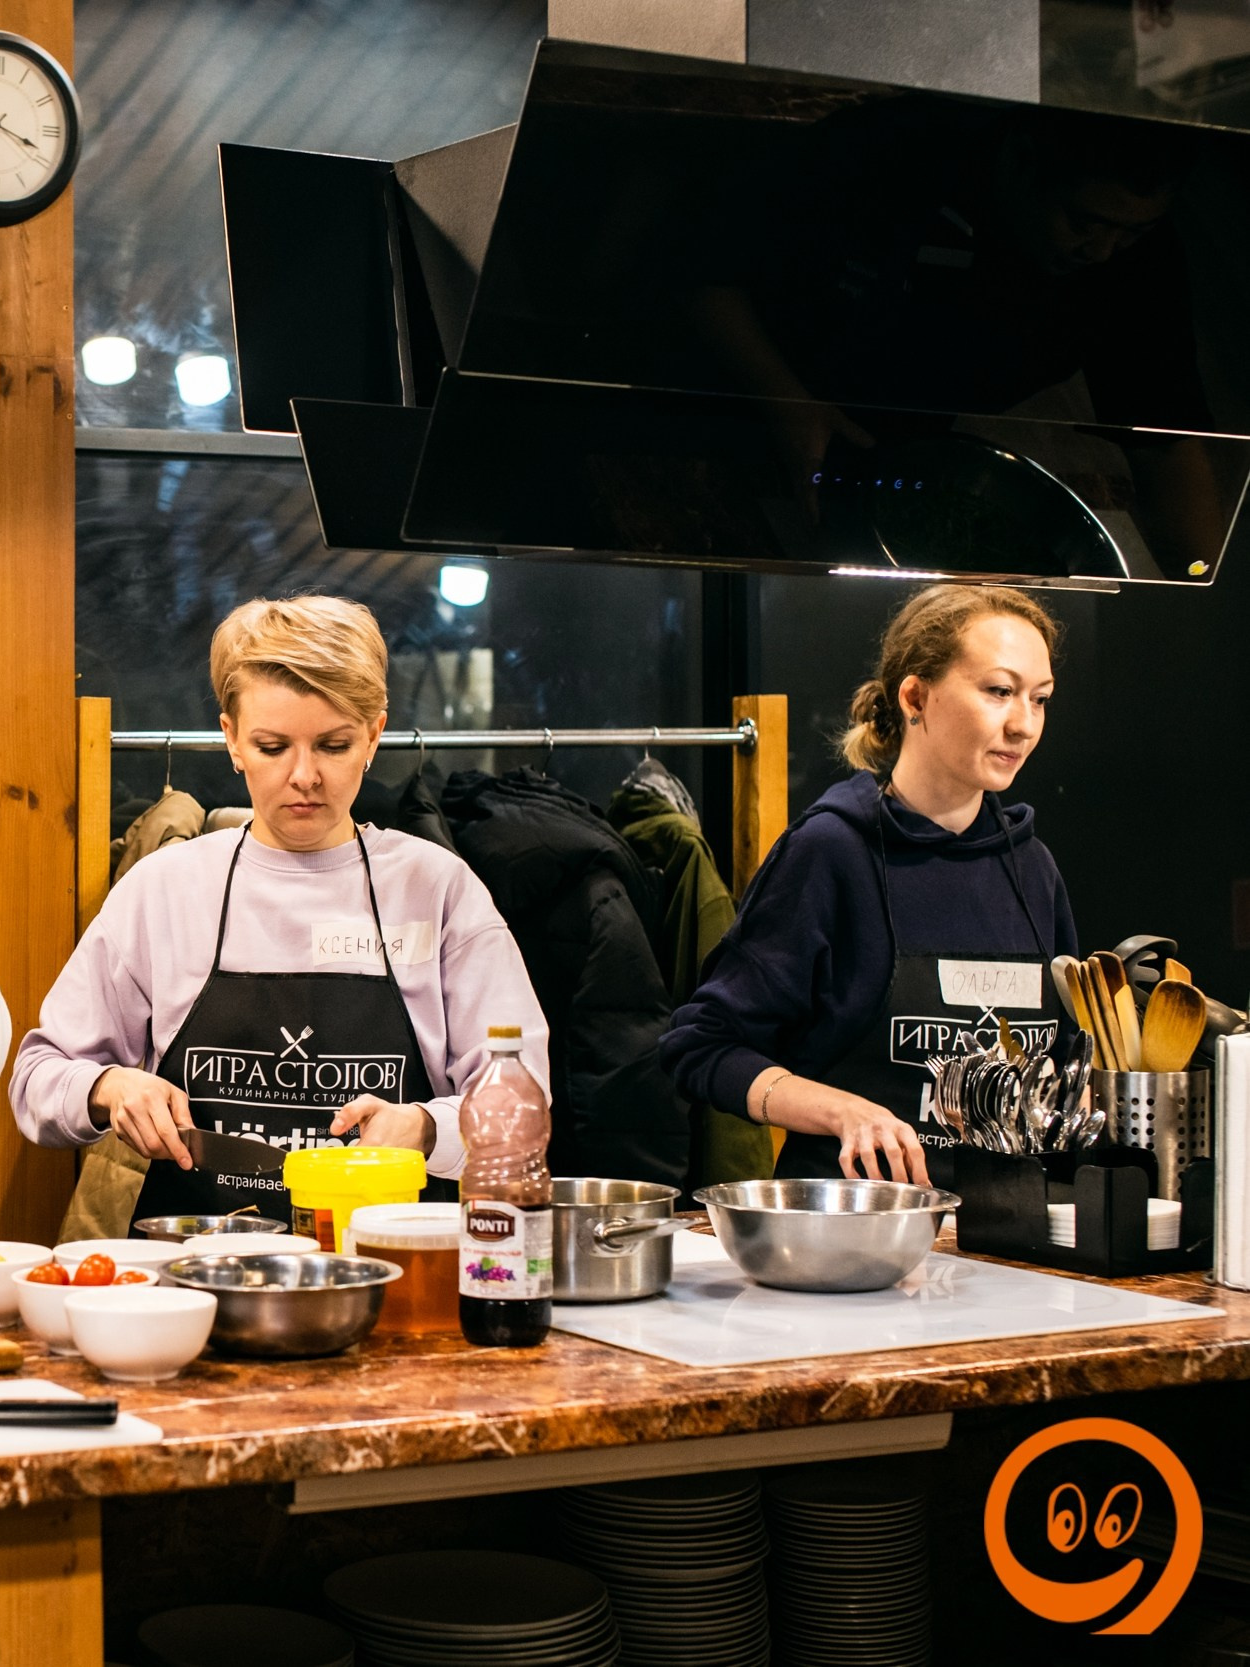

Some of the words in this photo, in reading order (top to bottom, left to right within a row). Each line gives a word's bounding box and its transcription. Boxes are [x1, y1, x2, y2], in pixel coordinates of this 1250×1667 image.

[318, 935, 404, 957] КСЕНИЯ
[952, 970, 1018, 995] ОЛЬГА
[899, 1023, 969, 1052] ИГРА
[191, 1054, 268, 1087] ИГРА
[274, 1060, 397, 1090] СТОЛОВ
[219, 1086, 306, 1101] КУЛИНАРНАЯ
[312, 1093, 362, 1104] СТУДИ
[316, 1126, 331, 1137] sin
[469, 1218, 510, 1233] PONTI
